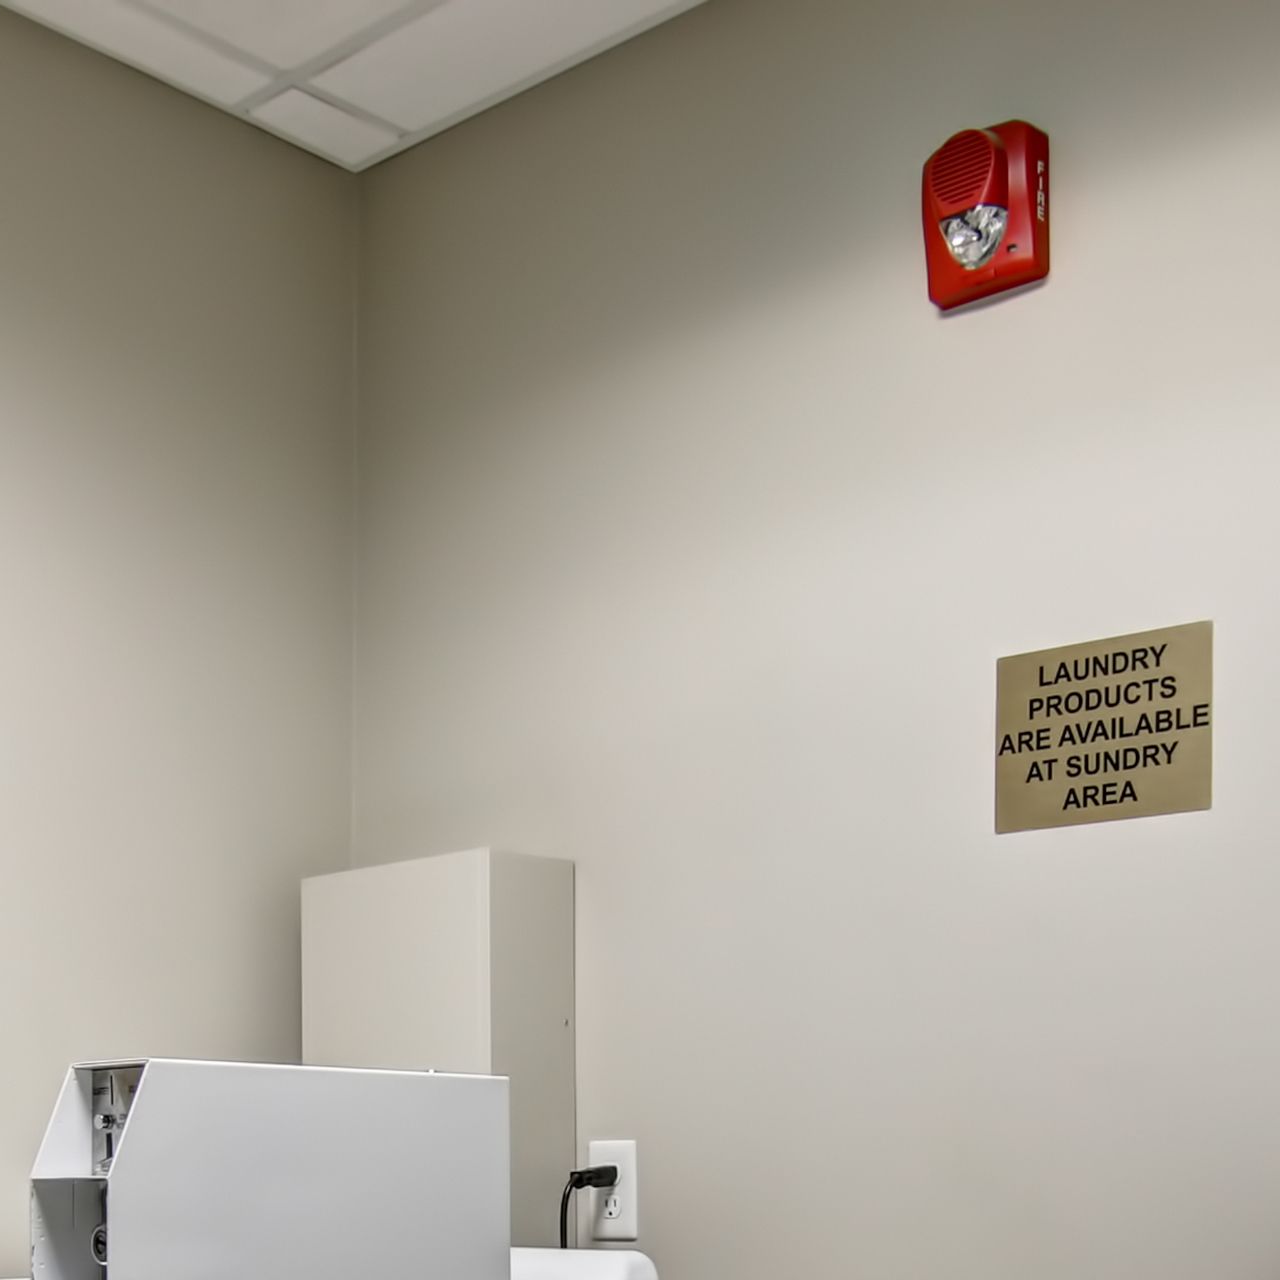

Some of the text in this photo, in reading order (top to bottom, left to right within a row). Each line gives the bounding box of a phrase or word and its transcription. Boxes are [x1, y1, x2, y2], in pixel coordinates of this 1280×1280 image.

[1037, 160, 1045, 222] FIRE
[1039, 643, 1168, 687] LAUNDRY
[1028, 676, 1177, 720] PRODUCTS
[998, 704, 1210, 756] ARE AVAILABLE
[1025, 741, 1179, 783] AT SUNDRY
[1062, 780, 1138, 810] AREA
